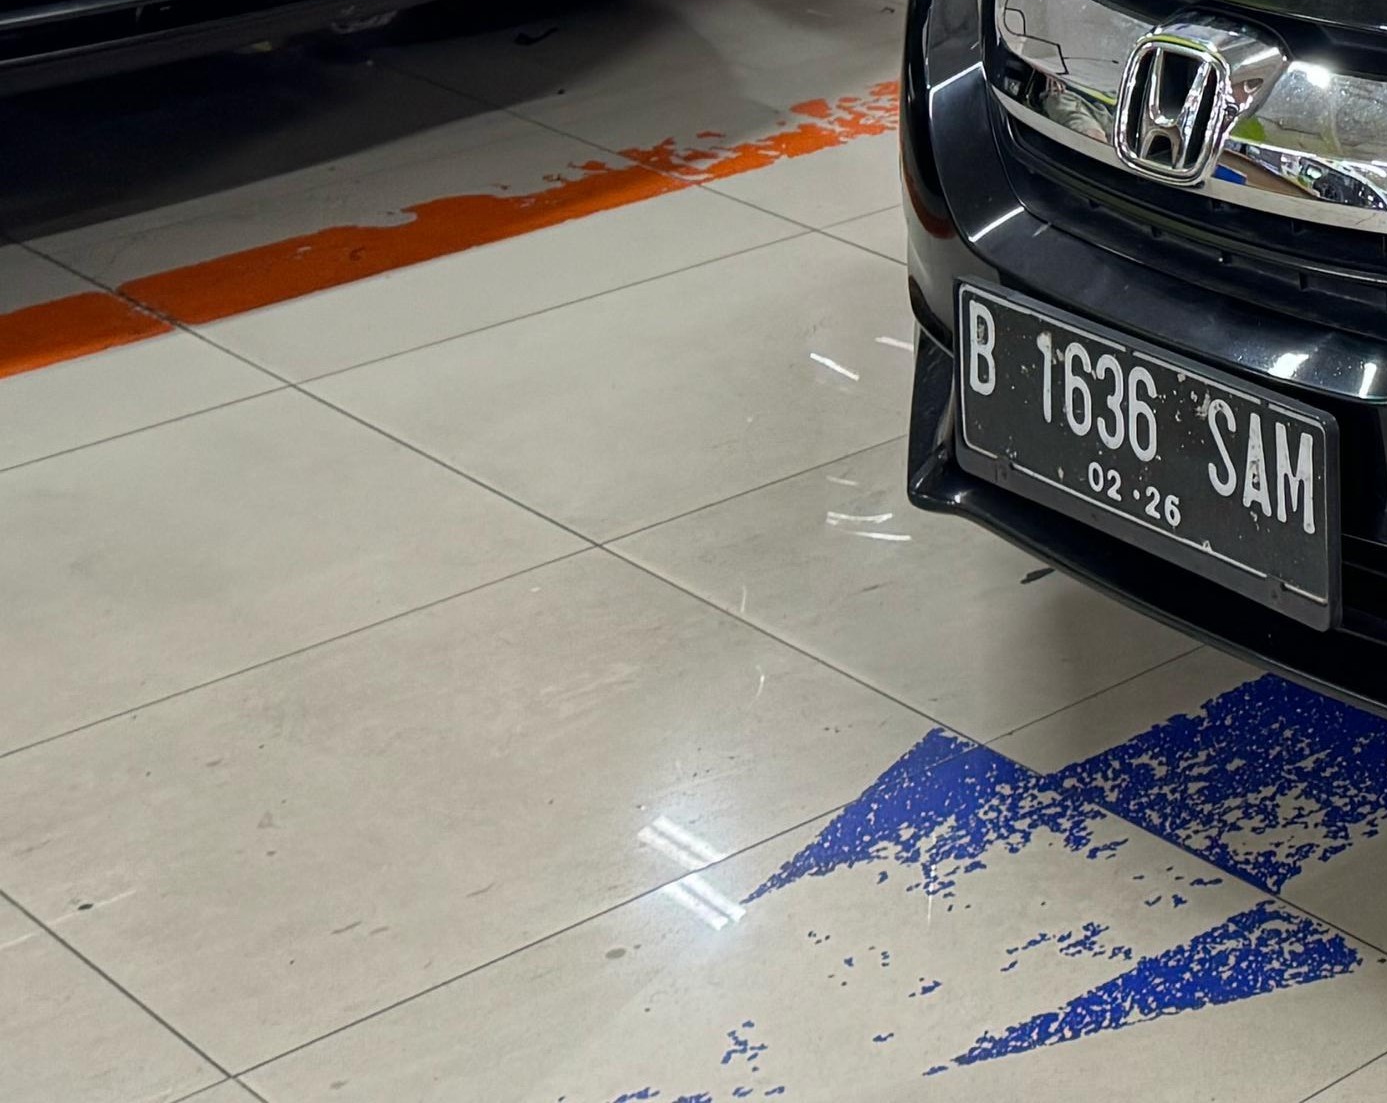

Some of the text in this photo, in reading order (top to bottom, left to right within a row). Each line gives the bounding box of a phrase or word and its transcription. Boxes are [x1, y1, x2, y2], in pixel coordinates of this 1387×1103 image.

[967, 299, 1317, 536] B 1636 SAM
